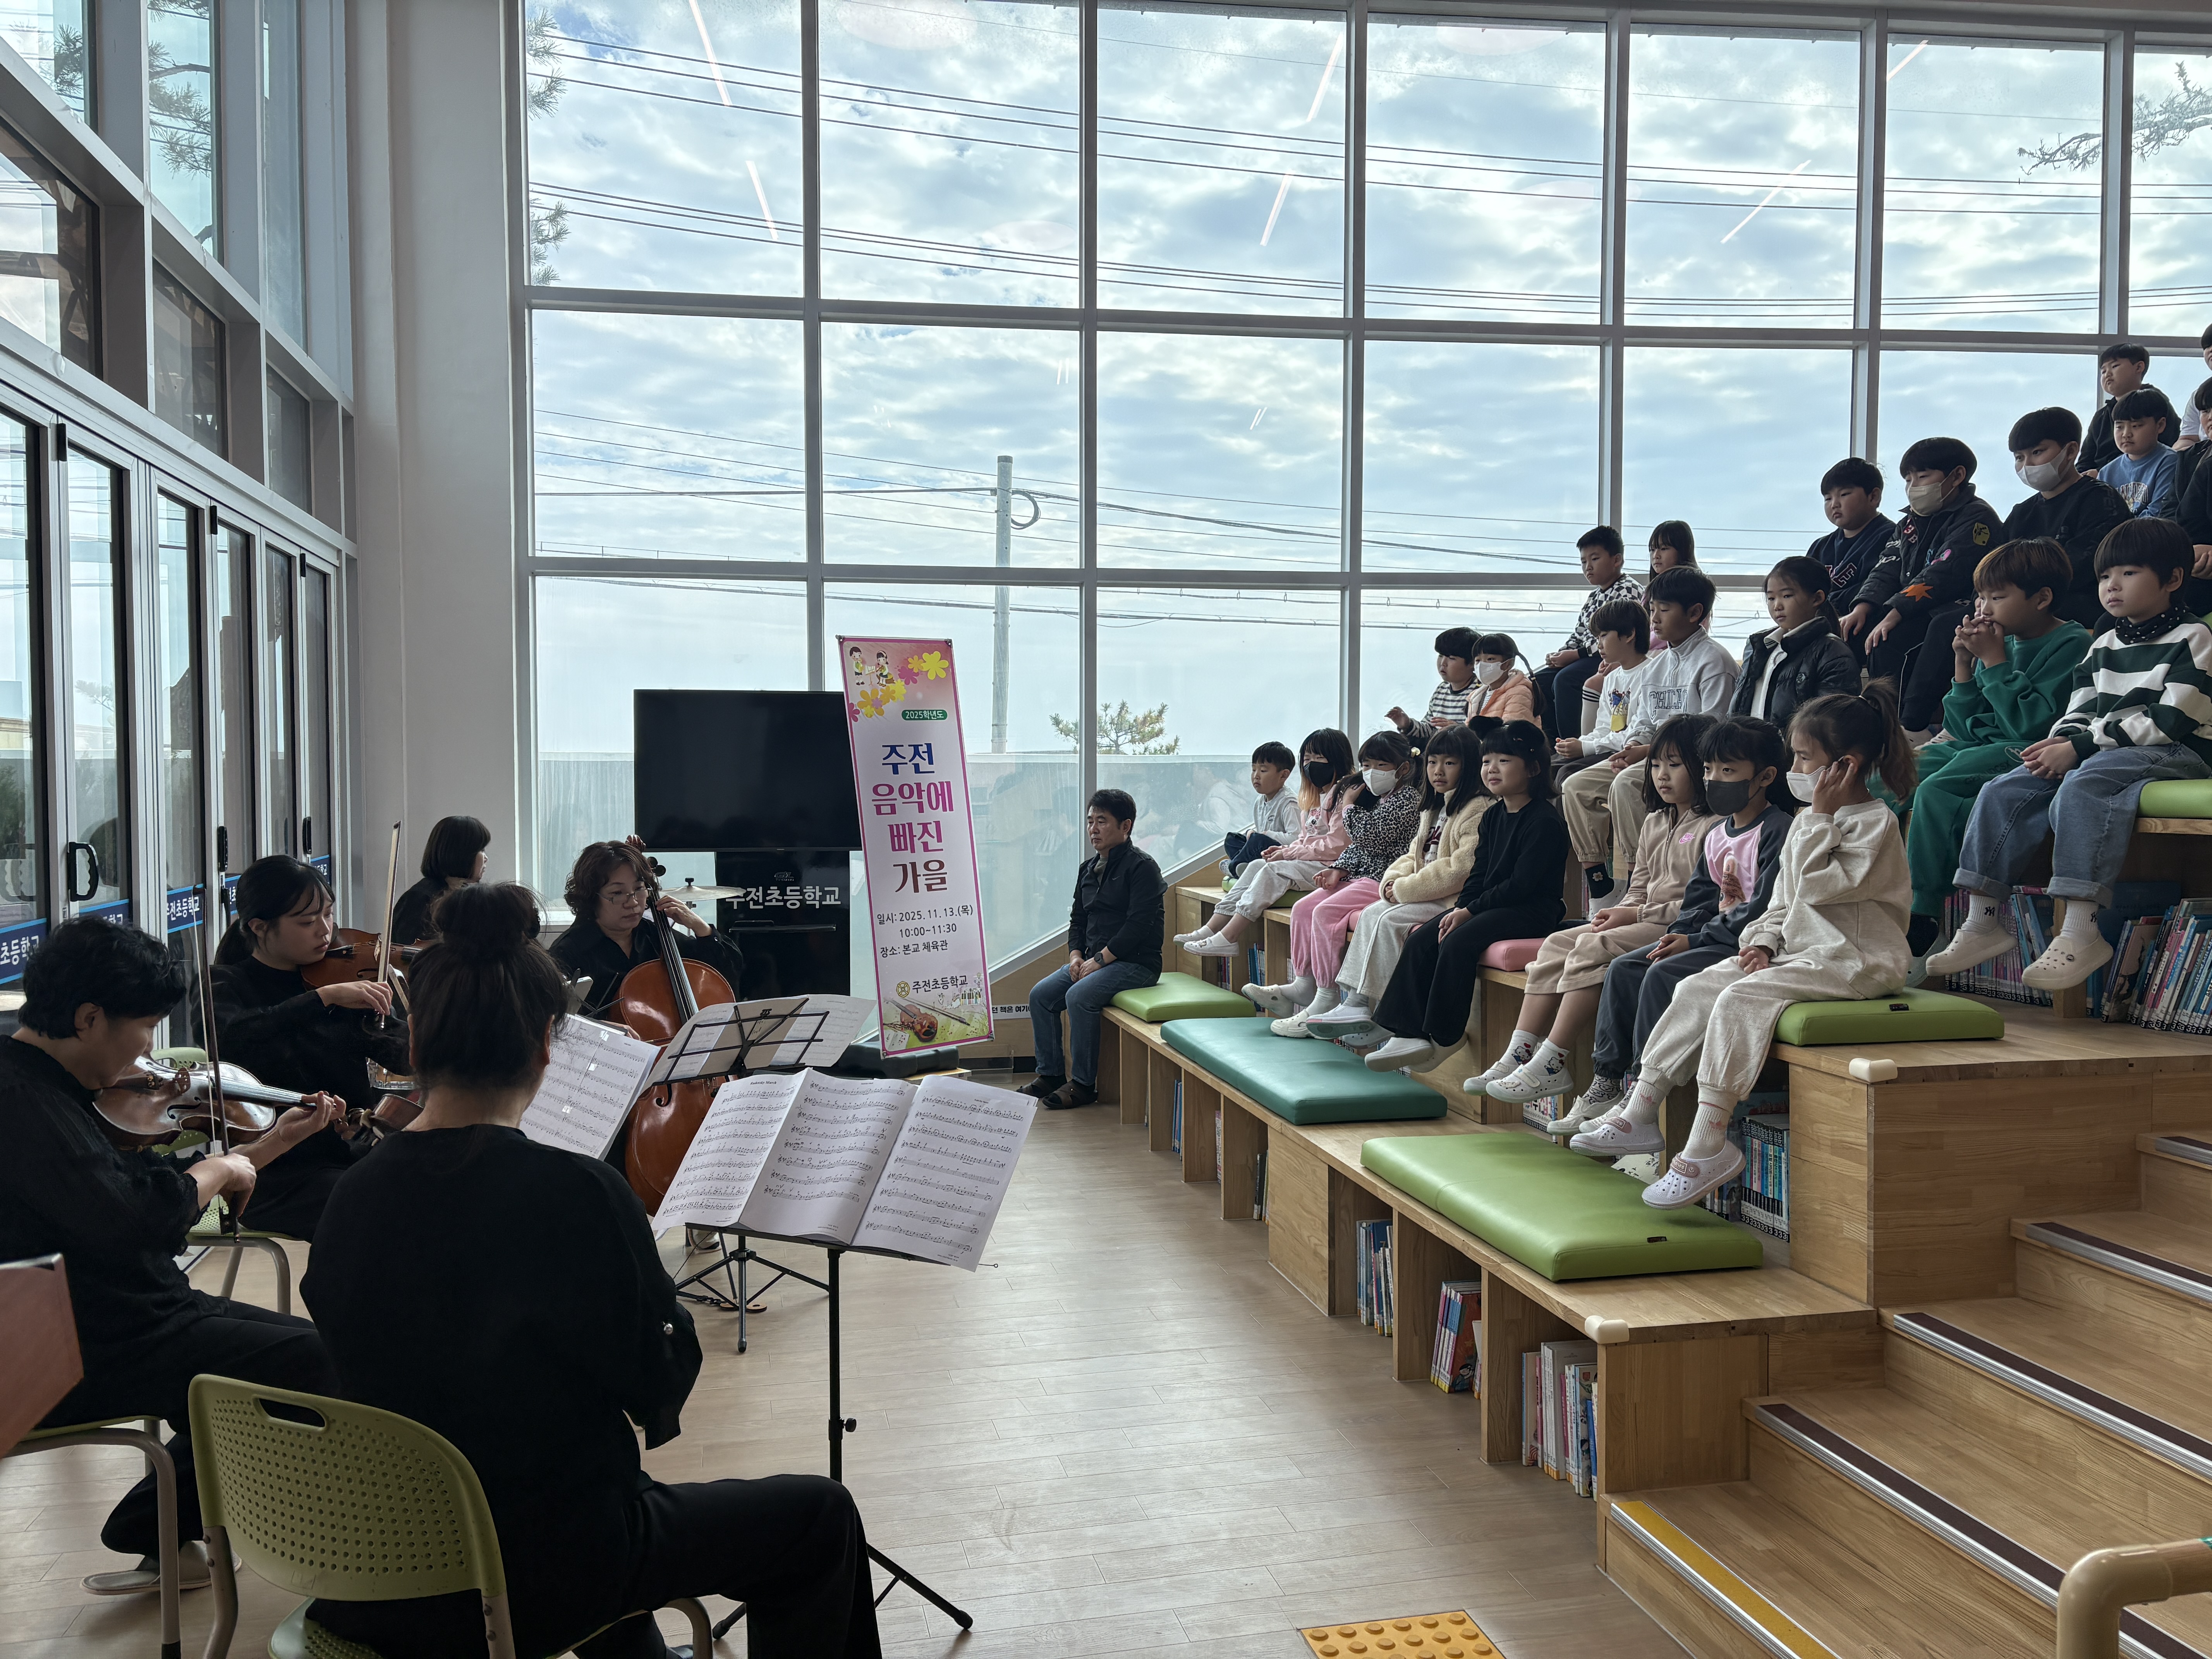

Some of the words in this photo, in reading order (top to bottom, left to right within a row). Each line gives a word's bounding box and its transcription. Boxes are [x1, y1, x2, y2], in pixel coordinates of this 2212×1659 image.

[905, 710, 944, 720] 2025학년도
[882, 743, 935, 775] 주전
[872, 781, 954, 815] 음악에
[888, 821, 943, 854] 빠진
[893, 860, 947, 893] 가을
[877, 912, 897, 925] 일시:
[899, 910, 926, 922] 2025.
[928, 909, 941, 919] 11.
[900, 923, 957, 938] 10:00~11:30
[880, 946, 901, 958] 장소:
[902, 944, 921, 955] 본교
[922, 939, 948, 953] 체육관
[912, 975, 968, 994] 주전초등학교
